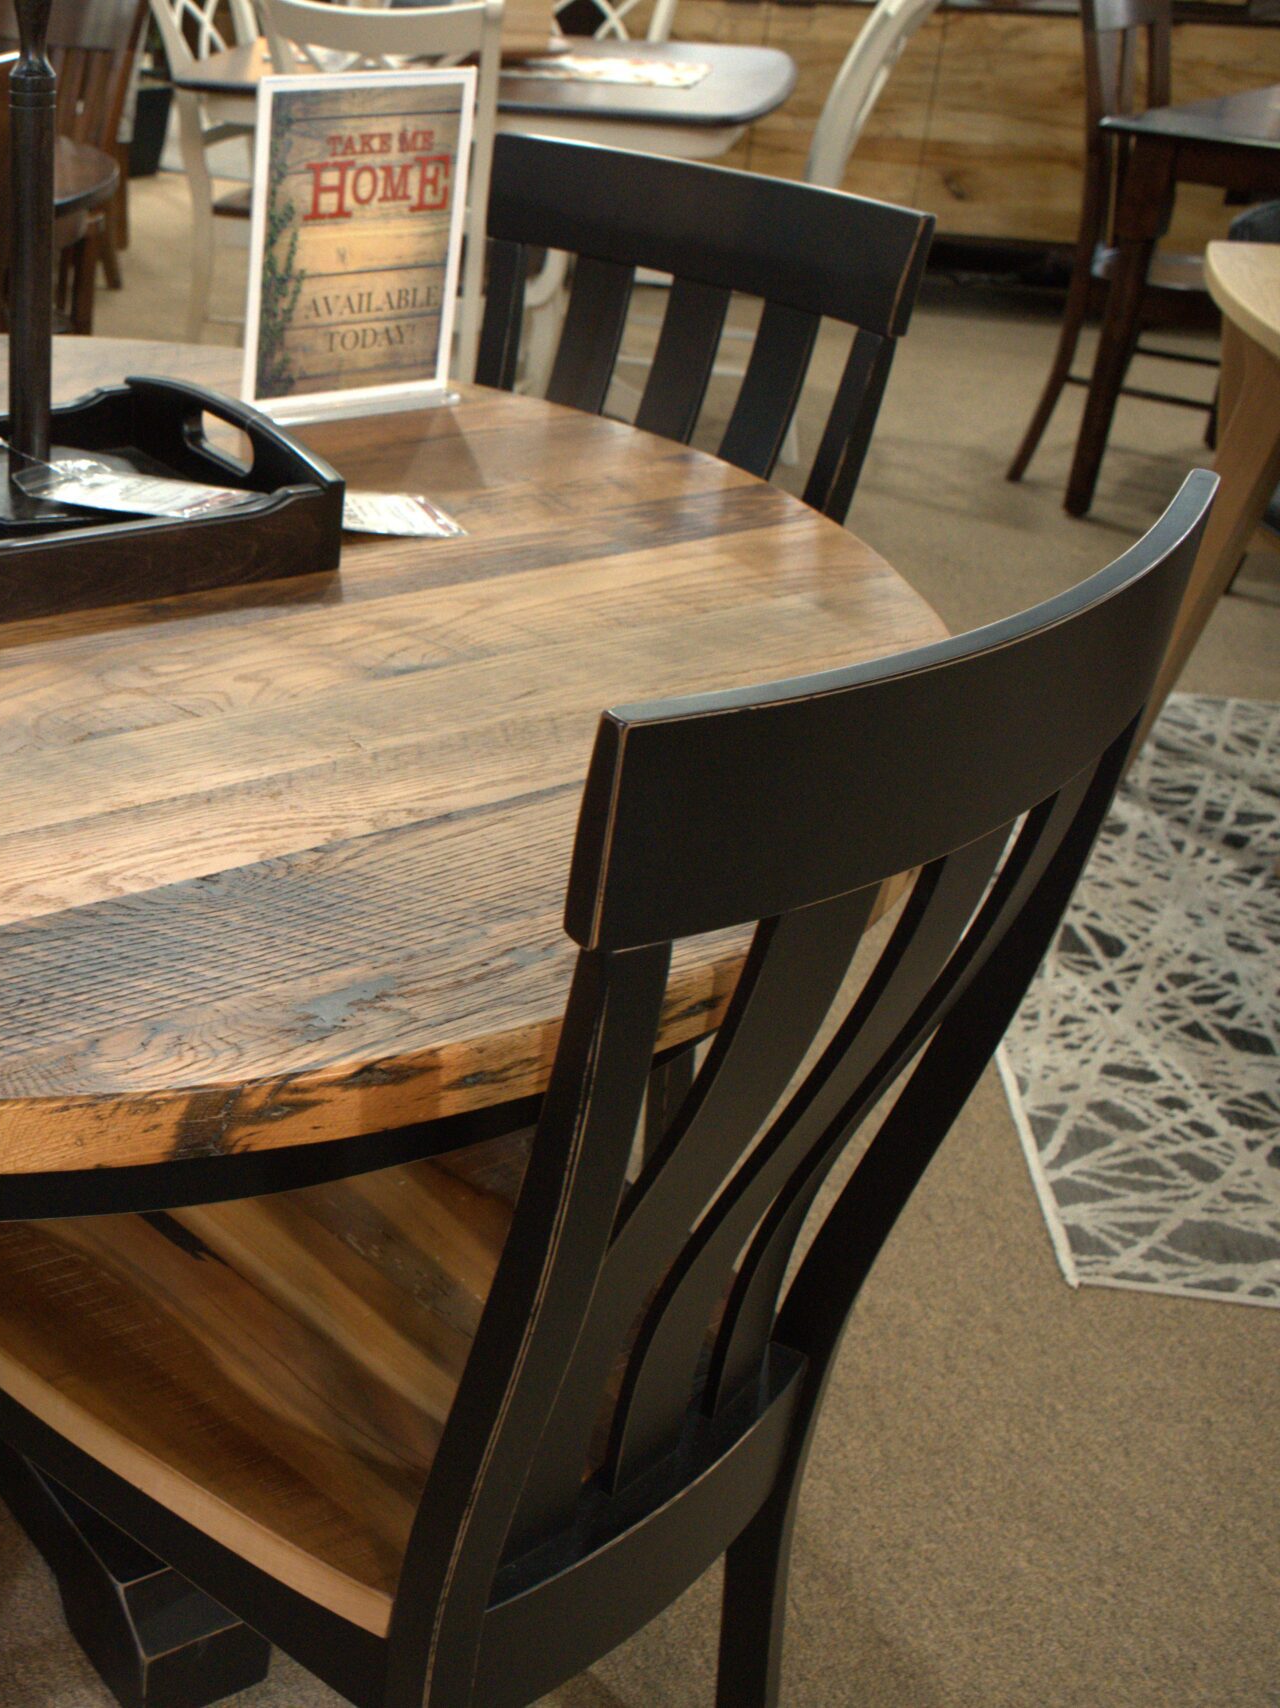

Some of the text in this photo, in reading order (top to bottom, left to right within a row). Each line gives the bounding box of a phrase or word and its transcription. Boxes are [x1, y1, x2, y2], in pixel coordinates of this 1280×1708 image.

[326, 129, 435, 157] TAKE ME
[303, 153, 451, 221] HOME
[305, 285, 440, 320] AVAILABLE
